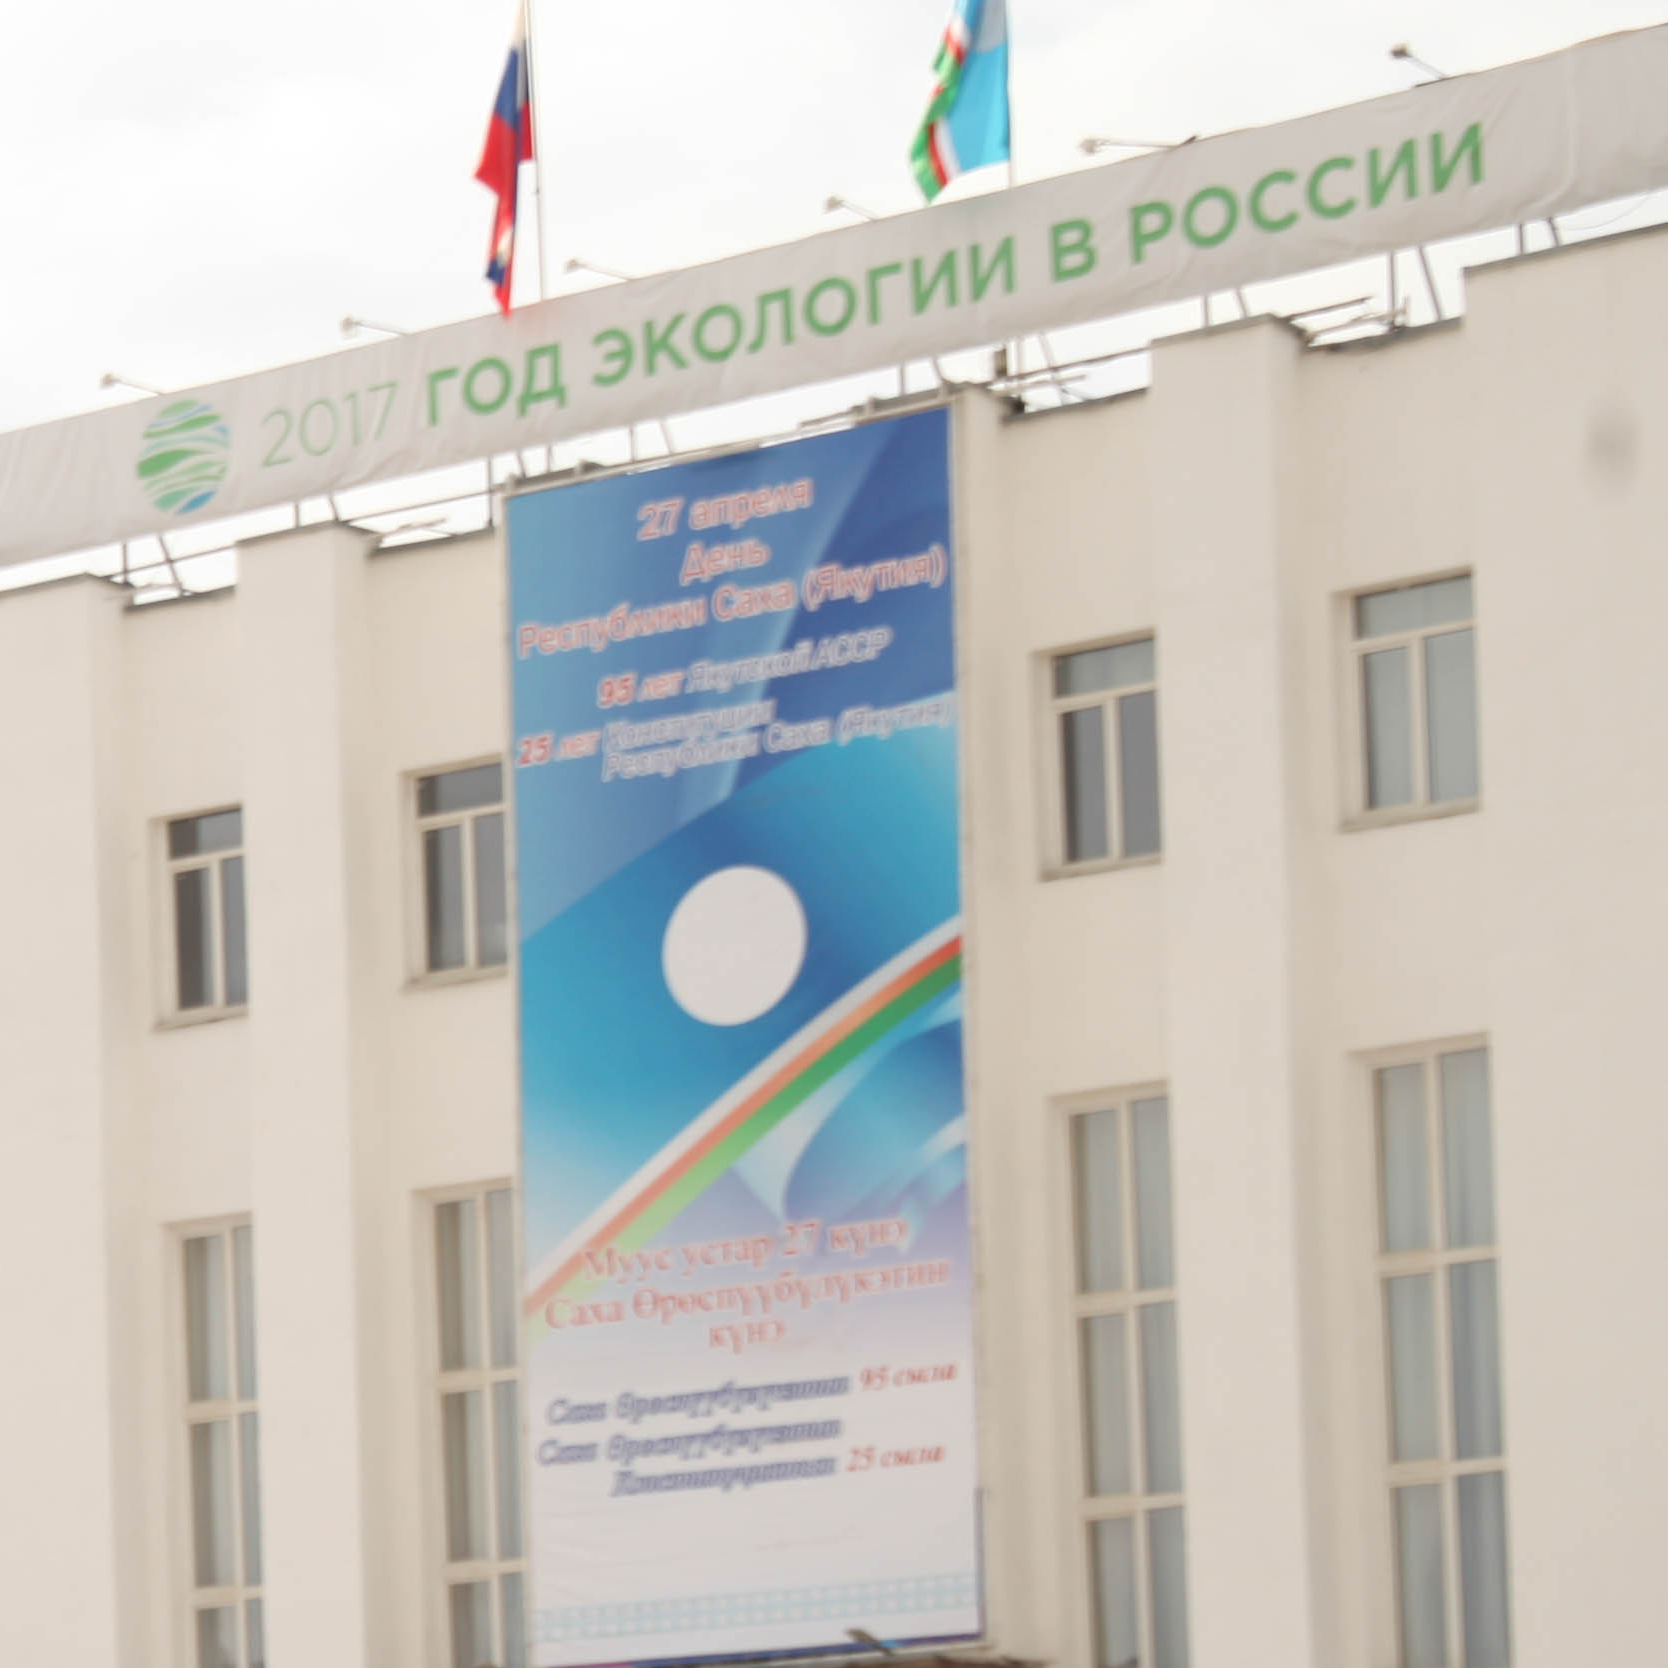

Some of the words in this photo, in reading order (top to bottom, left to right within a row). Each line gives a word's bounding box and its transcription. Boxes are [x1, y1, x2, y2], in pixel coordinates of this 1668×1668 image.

[263, 380, 399, 468] 2017
[427, 342, 568, 426] ГОД
[592, 236, 1016, 386] ЭКОЛОГИИ
[1051, 218, 1096, 282] В
[1128, 122, 1483, 265] РОССИИ
[637, 498, 683, 540] 27
[690, 478, 812, 530] апреля
[680, 538, 771, 586] День
[518, 598, 706, 660] Республики
[712, 580, 796, 622] Саха
[801, 542, 947, 611] (Якутия)
[597, 671, 637, 709] 95
[518, 731, 562, 768] 25
